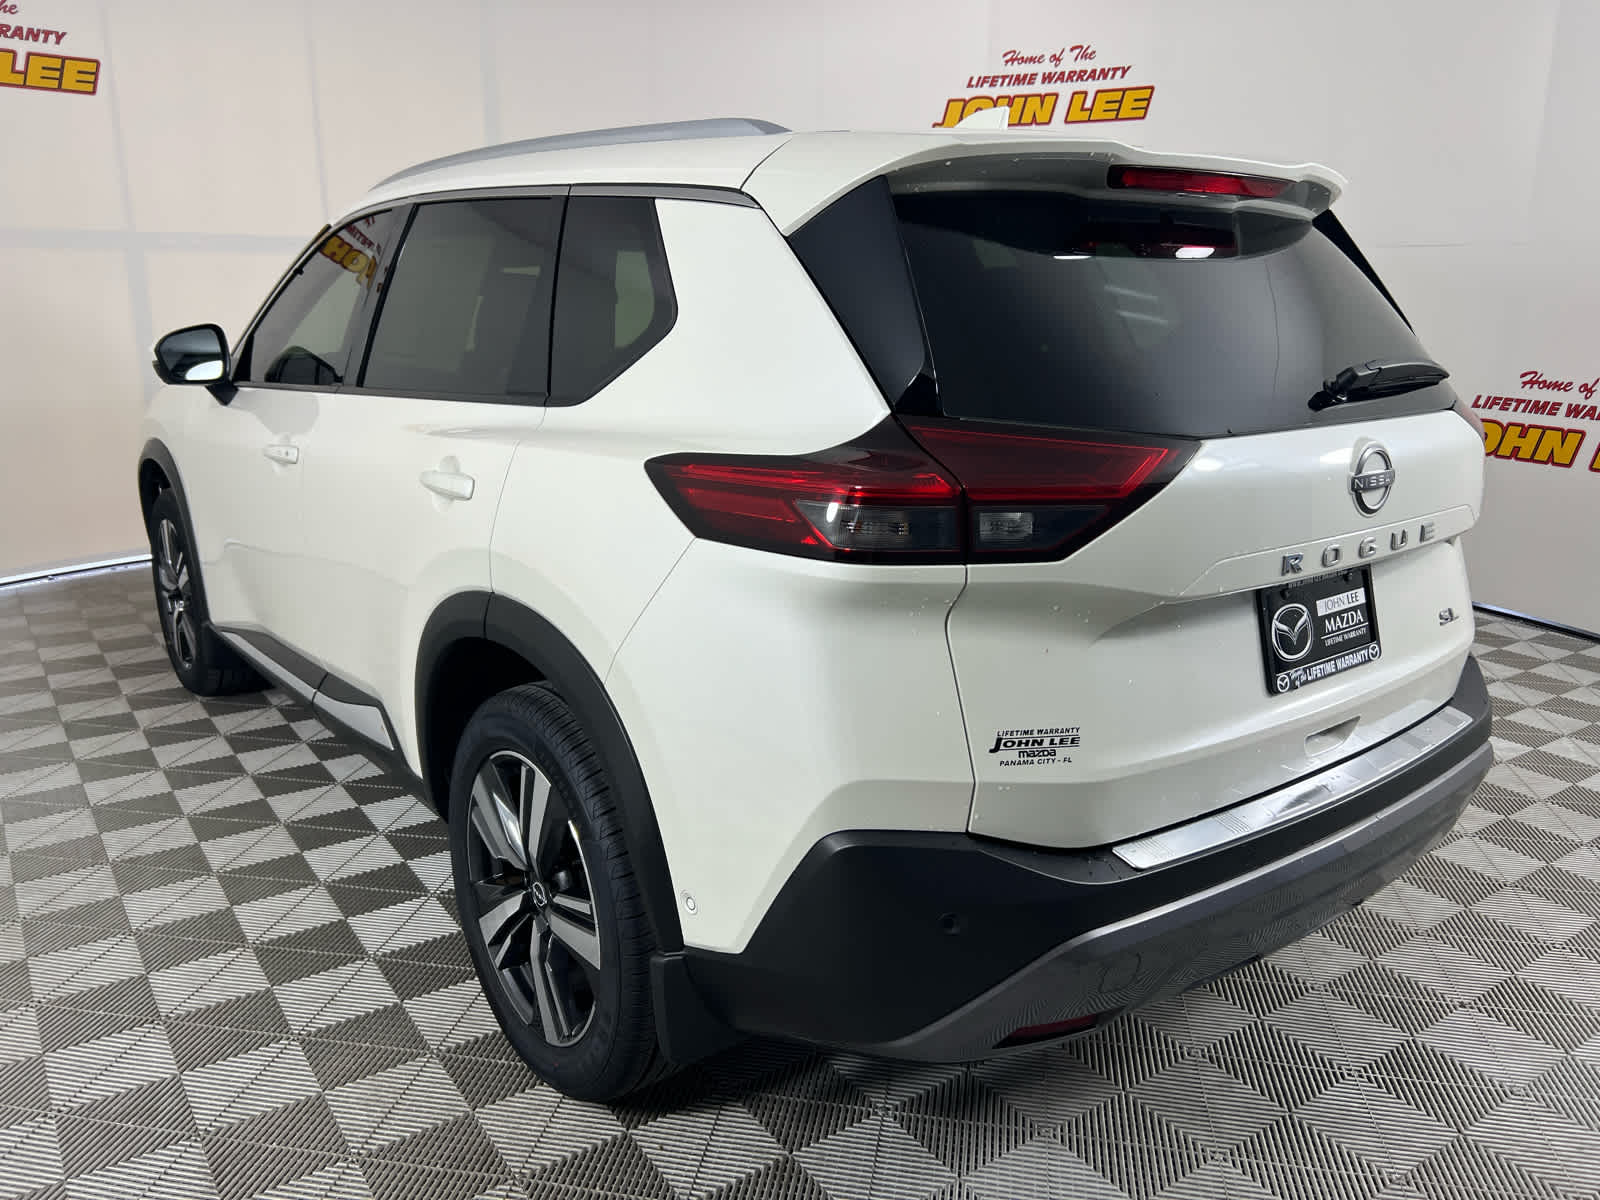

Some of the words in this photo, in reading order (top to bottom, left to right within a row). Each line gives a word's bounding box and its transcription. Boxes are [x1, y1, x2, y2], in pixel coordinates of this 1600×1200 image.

[0, 24, 67, 45] RANTY
[1002, 50, 1045, 66] Home
[1049, 49, 1065, 67] of
[1070, 45, 1096, 62] The
[966, 73, 1037, 88] LIFETIME
[1041, 66, 1132, 84] WARRANTY
[1064, 85, 1155, 124] LEE
[1520, 371, 1574, 392] Home
[1578, 378, 1600, 400] of
[1471, 395, 1563, 416] LIFETIME
[1480, 418, 1586, 468] OHN
[1281, 521, 1435, 576] ROGUE
[1324, 598, 1345, 612] JOHN
[1347, 591, 1360, 602] LEE
[1325, 609, 1363, 633] MAZDA
[1438, 607, 1460, 626] SL
[1325, 635, 1343, 647] LIFETIME
[1343, 627, 1367, 640] WARRANTY
[1306, 661, 1336, 680] LIFETIME
[1336, 649, 1368, 670] WARRANTY
[1037, 727, 1080, 735] WARRANTY
[989, 737, 1044, 753] JOHN
[1049, 737, 1080, 746] LEE
[1018, 749, 1057, 758] mazda
[1000, 759, 1035, 767] PANAMA
[1037, 757, 1056, 765] CITY
